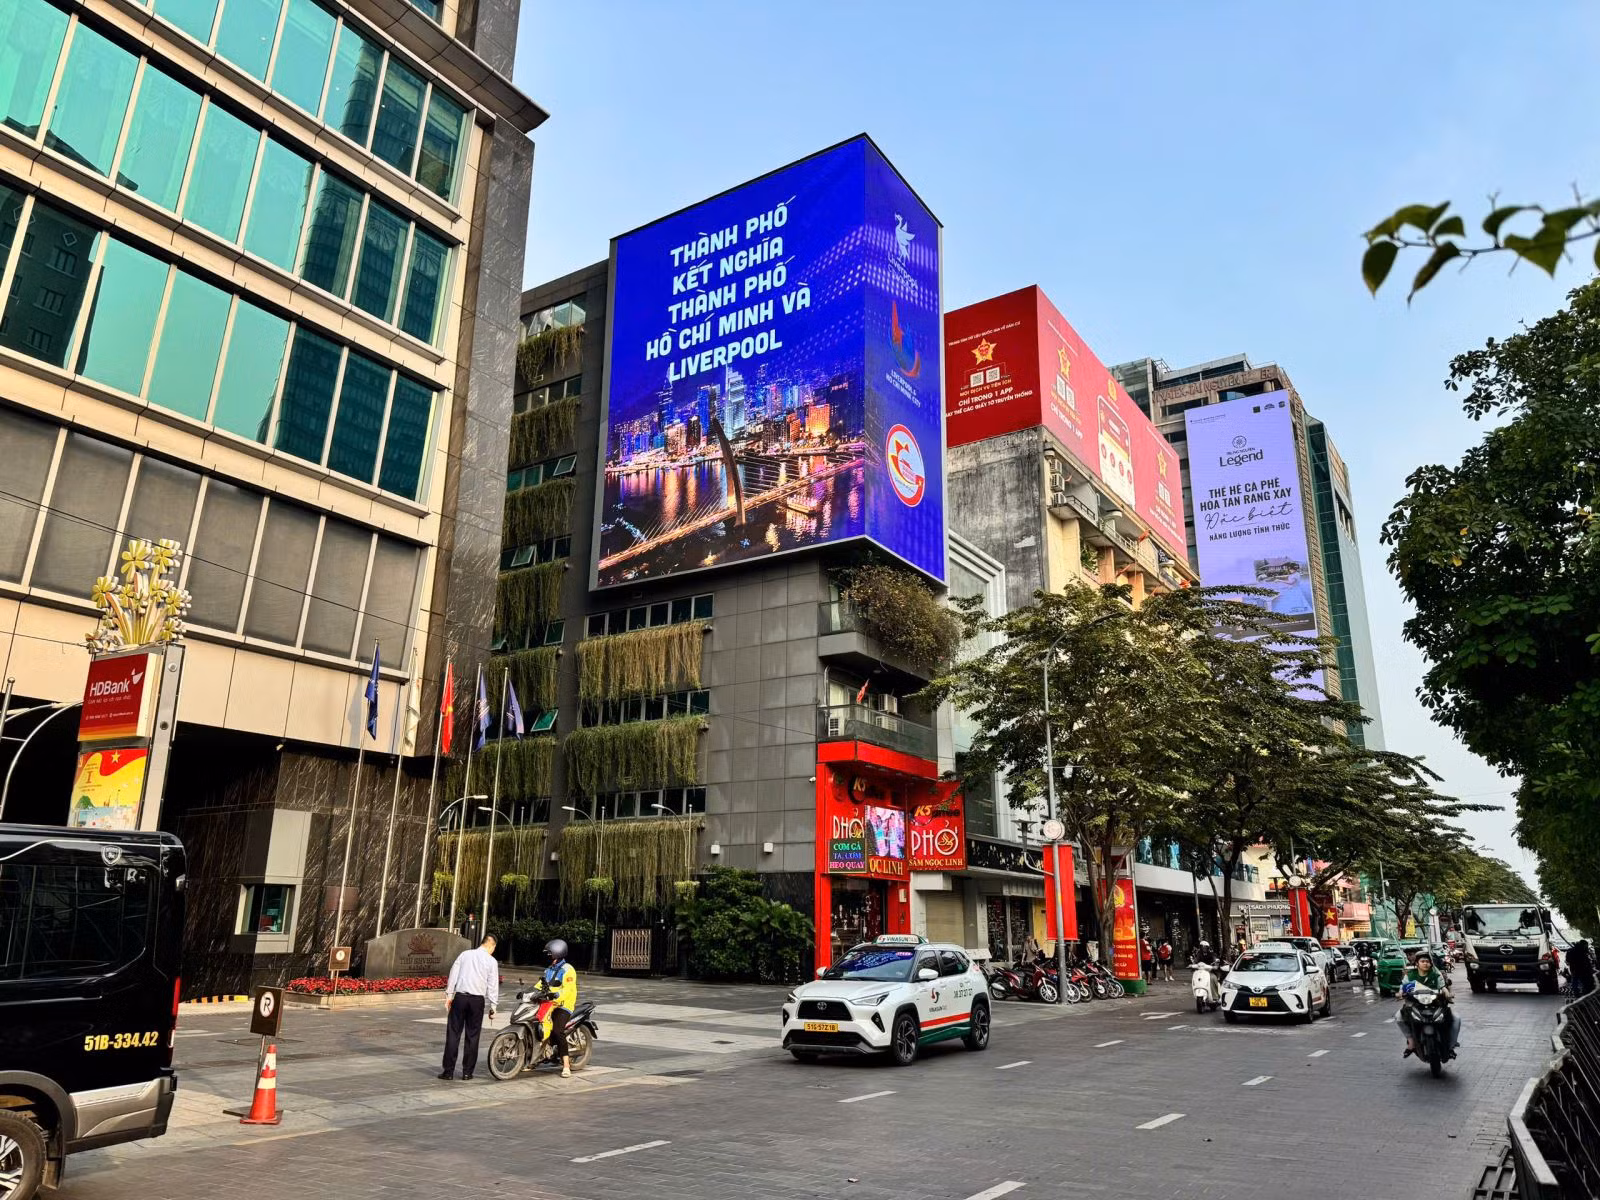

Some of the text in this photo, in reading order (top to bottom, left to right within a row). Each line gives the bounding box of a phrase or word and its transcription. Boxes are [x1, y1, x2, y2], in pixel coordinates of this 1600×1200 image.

[670, 195, 796, 267] THÀNH PHỐ
[672, 236, 783, 295] KẾT NGHĨA
[668, 255, 795, 324] THÀNH PHỐ
[646, 282, 810, 361] HỒ CHÍ MINH VÀ
[669, 329, 782, 382] LIVERPOOL
[971, 392, 994, 403] TRONG
[999, 386, 1014, 396] APP
[1219, 449, 1264, 467] Legend
[1223, 496, 1241, 508] TAN
[1243, 491, 1271, 505] RANG
[1273, 487, 1292, 500] XAY
[89, 678, 131, 697] HDBank
[914, 804, 932, 817] K5
[883, 860, 904, 875] LINH
[944, 858, 963, 867] LINH
[84, 1031, 159, 1051] 51B-334.42
